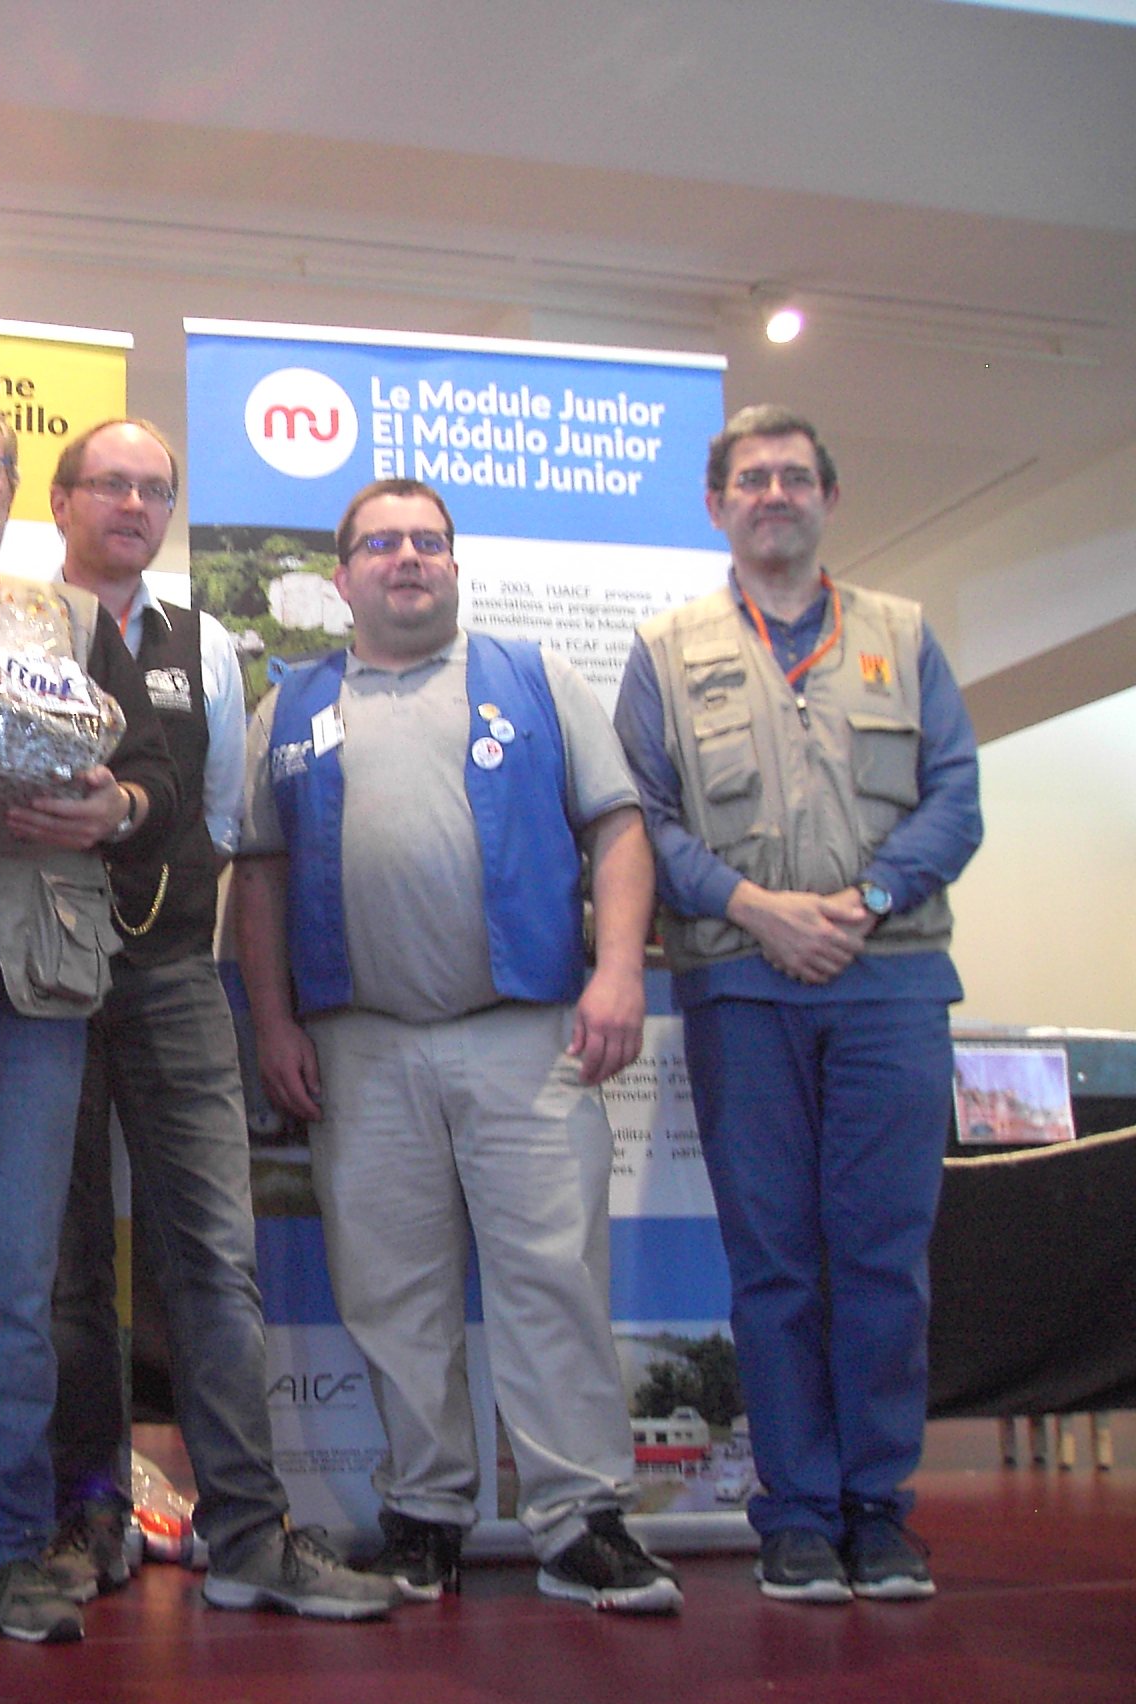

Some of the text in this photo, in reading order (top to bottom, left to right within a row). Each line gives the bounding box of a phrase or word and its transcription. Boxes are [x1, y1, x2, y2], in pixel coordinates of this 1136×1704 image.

[0, 402, 70, 436] rillo
[371, 376, 665, 428] Le Module Junior
[373, 413, 663, 463] El Módulo Junior
[373, 448, 643, 496] El Mòdul Junior
